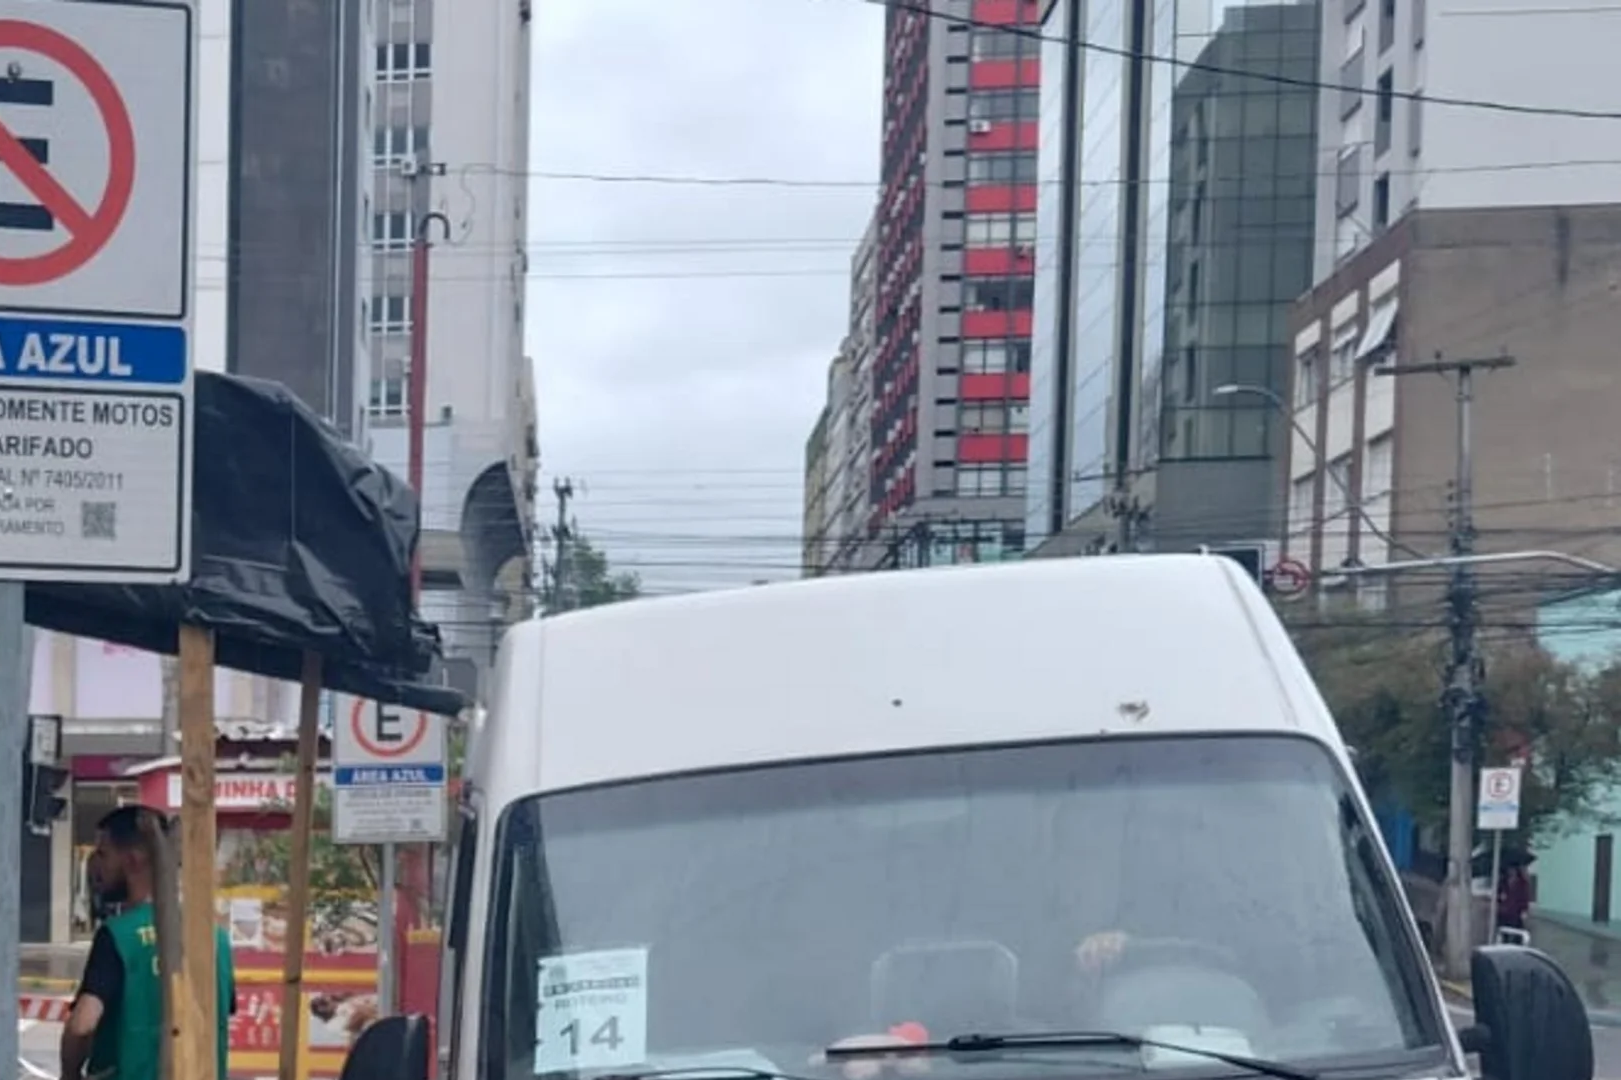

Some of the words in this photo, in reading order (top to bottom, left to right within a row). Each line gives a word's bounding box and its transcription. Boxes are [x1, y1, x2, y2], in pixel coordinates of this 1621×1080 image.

[17, 332, 133, 377] AZUL
[92, 402, 174, 428] MOTOS
[559, 1015, 624, 1056] 14
